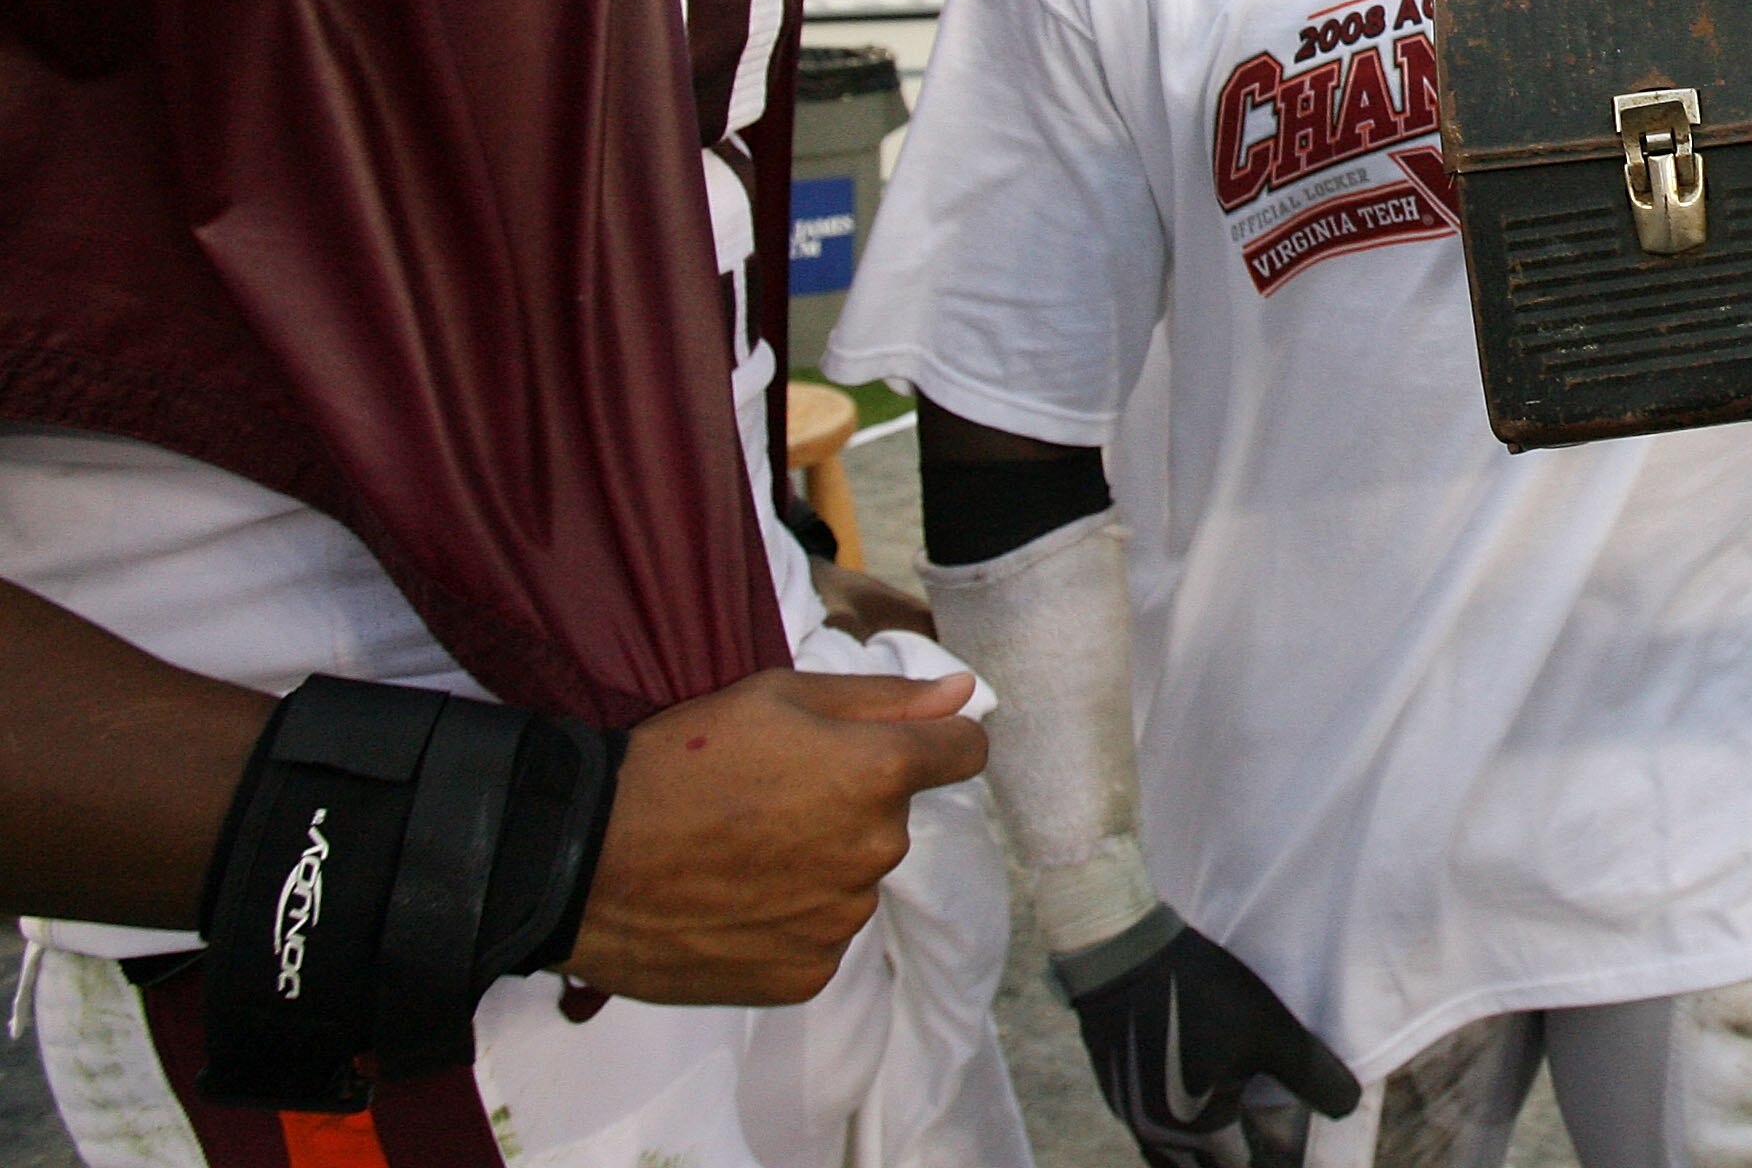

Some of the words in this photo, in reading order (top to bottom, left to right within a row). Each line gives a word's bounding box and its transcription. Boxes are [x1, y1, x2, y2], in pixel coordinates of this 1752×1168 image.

[1294, 4, 1386, 63] 2008
[1230, 193, 1300, 243] OFFICIAL
[1301, 167, 1371, 206] LOCKER
[1251, 212, 1357, 279] VIRGINIA
[1357, 195, 1421, 231] TECH
